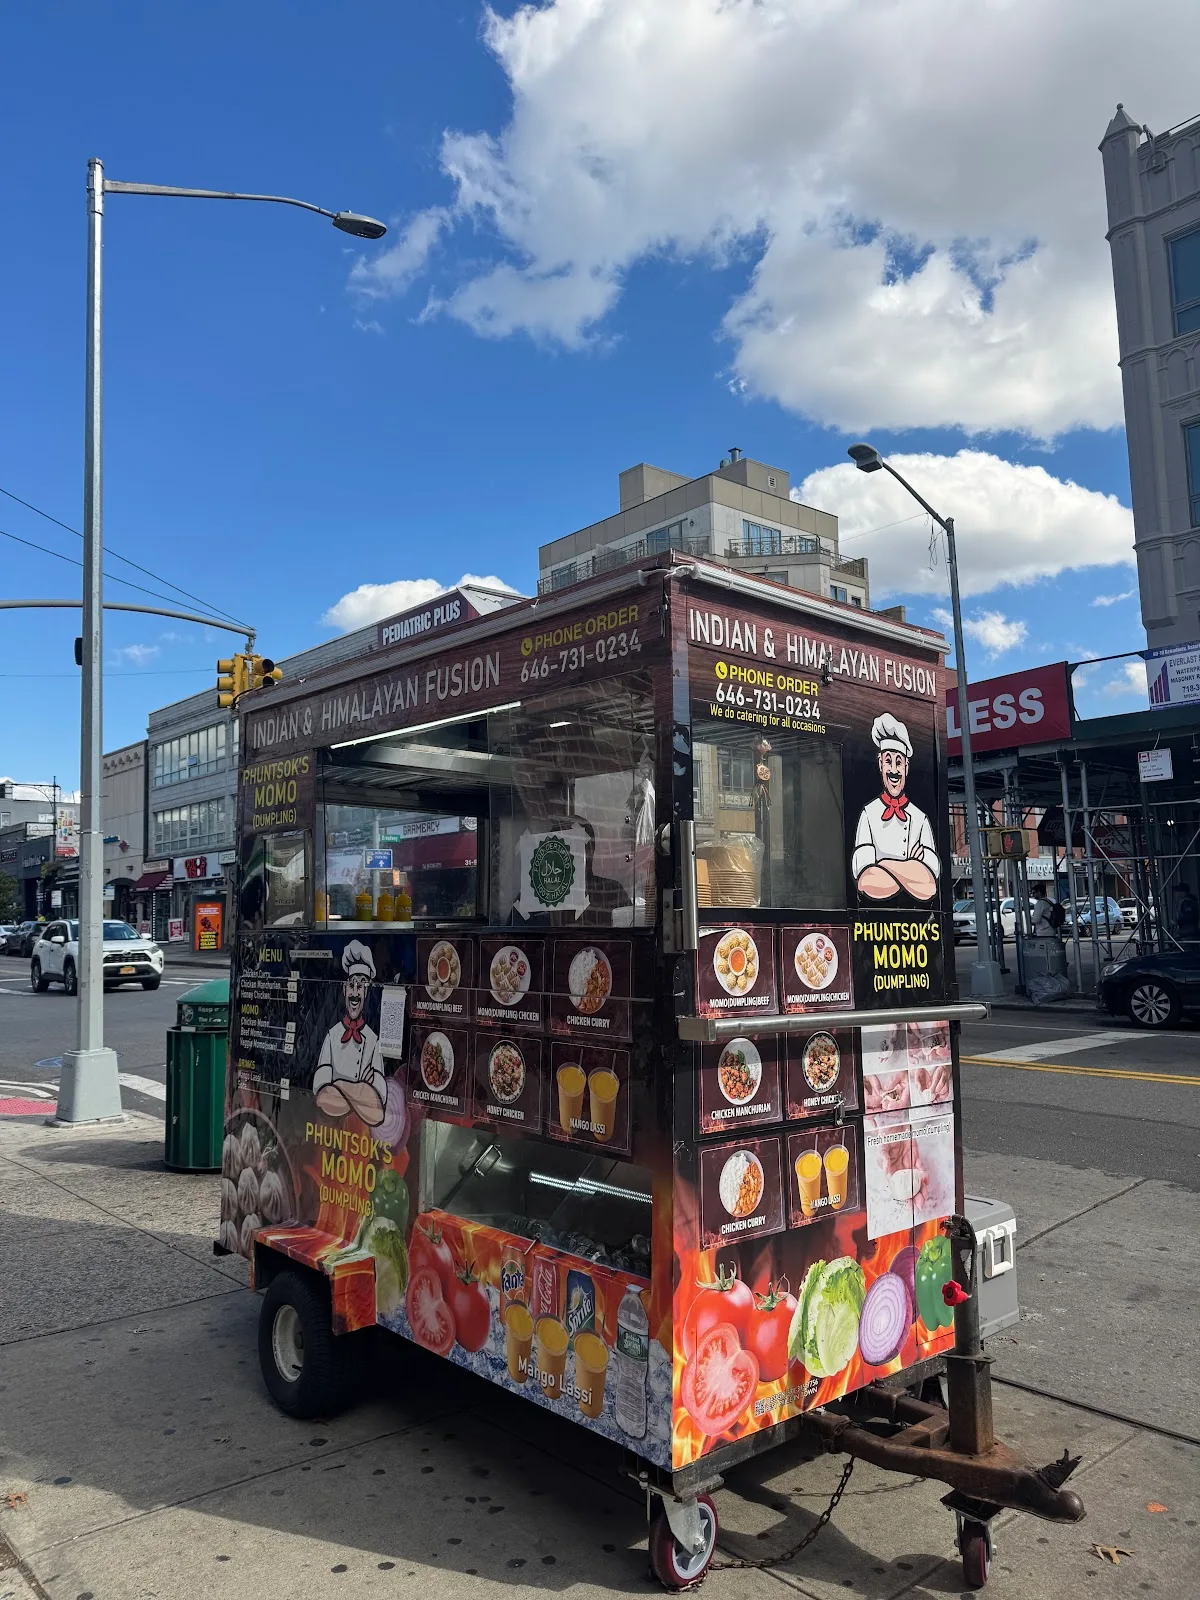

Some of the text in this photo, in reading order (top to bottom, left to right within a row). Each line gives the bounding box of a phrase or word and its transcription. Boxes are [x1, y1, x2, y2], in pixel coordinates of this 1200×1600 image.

[382, 599, 462, 646] PEDIATRIC PLUS
[534, 604, 639, 652] PHONE ORDER
[520, 629, 642, 684] 646-731-0234
[689, 608, 937, 697] INDIAN & HIMALAYAN FUSION
[1169, 655, 1198, 667] EVERLAST
[729, 664, 819, 697] PHONE ORDER
[253, 652, 500, 749] INDIAN & HIMALAYAN FUSION
[715, 682, 820, 720] 646-731-0234
[710, 703, 826, 734] We do catering for all occasions
[946, 687, 1045, 739] LESS
[242, 755, 310, 787] PHUNTSOK'S
[254, 780, 297, 809] MOMO
[252, 808, 297, 830] (DUMPLING)
[541, 860, 563, 876] حلال
[551, 882, 568, 899] HALAL
[853, 922, 940, 942] PHUNTSOK'S
[259, 948, 282, 962] MENU
[873, 944, 928, 969] MOMO
[873, 973, 930, 991] (DUMPLING)
[240, 989, 253, 1000] Honey
[241, 1003, 259, 1015] MOMO
[453, 1004, 463, 1014] BEEF
[477, 1007, 540, 1022] MOMO(DUMPLING) CHICKEN
[566, 1015, 610, 1029] CHICKEN CURRY
[412, 1090, 459, 1106] CHICKEN MANCHURIAN
[803, 1094, 842, 1108] HONEY CHICKE
[487, 1105, 525, 1121] HONEY CHICKEN
[711, 1103, 772, 1121] CHICKEN MANCHURIAN
[569, 1117, 606, 1135] MANGO LASSI
[305, 1121, 392, 1164] PHUNTSOK'S
[867, 1135, 883, 1147] Fresh
[883, 1129, 911, 1143] homemade
[322, 1150, 376, 1193] MOMO
[320, 1184, 374, 1220] (DUMPLING)
[827, 1193, 841, 1206] LASSI
[721, 1215, 766, 1235] CHICKEN CURRY
[568, 1298, 592, 1338] Sprite
[518, 1355, 592, 1405] Mango Lassi
